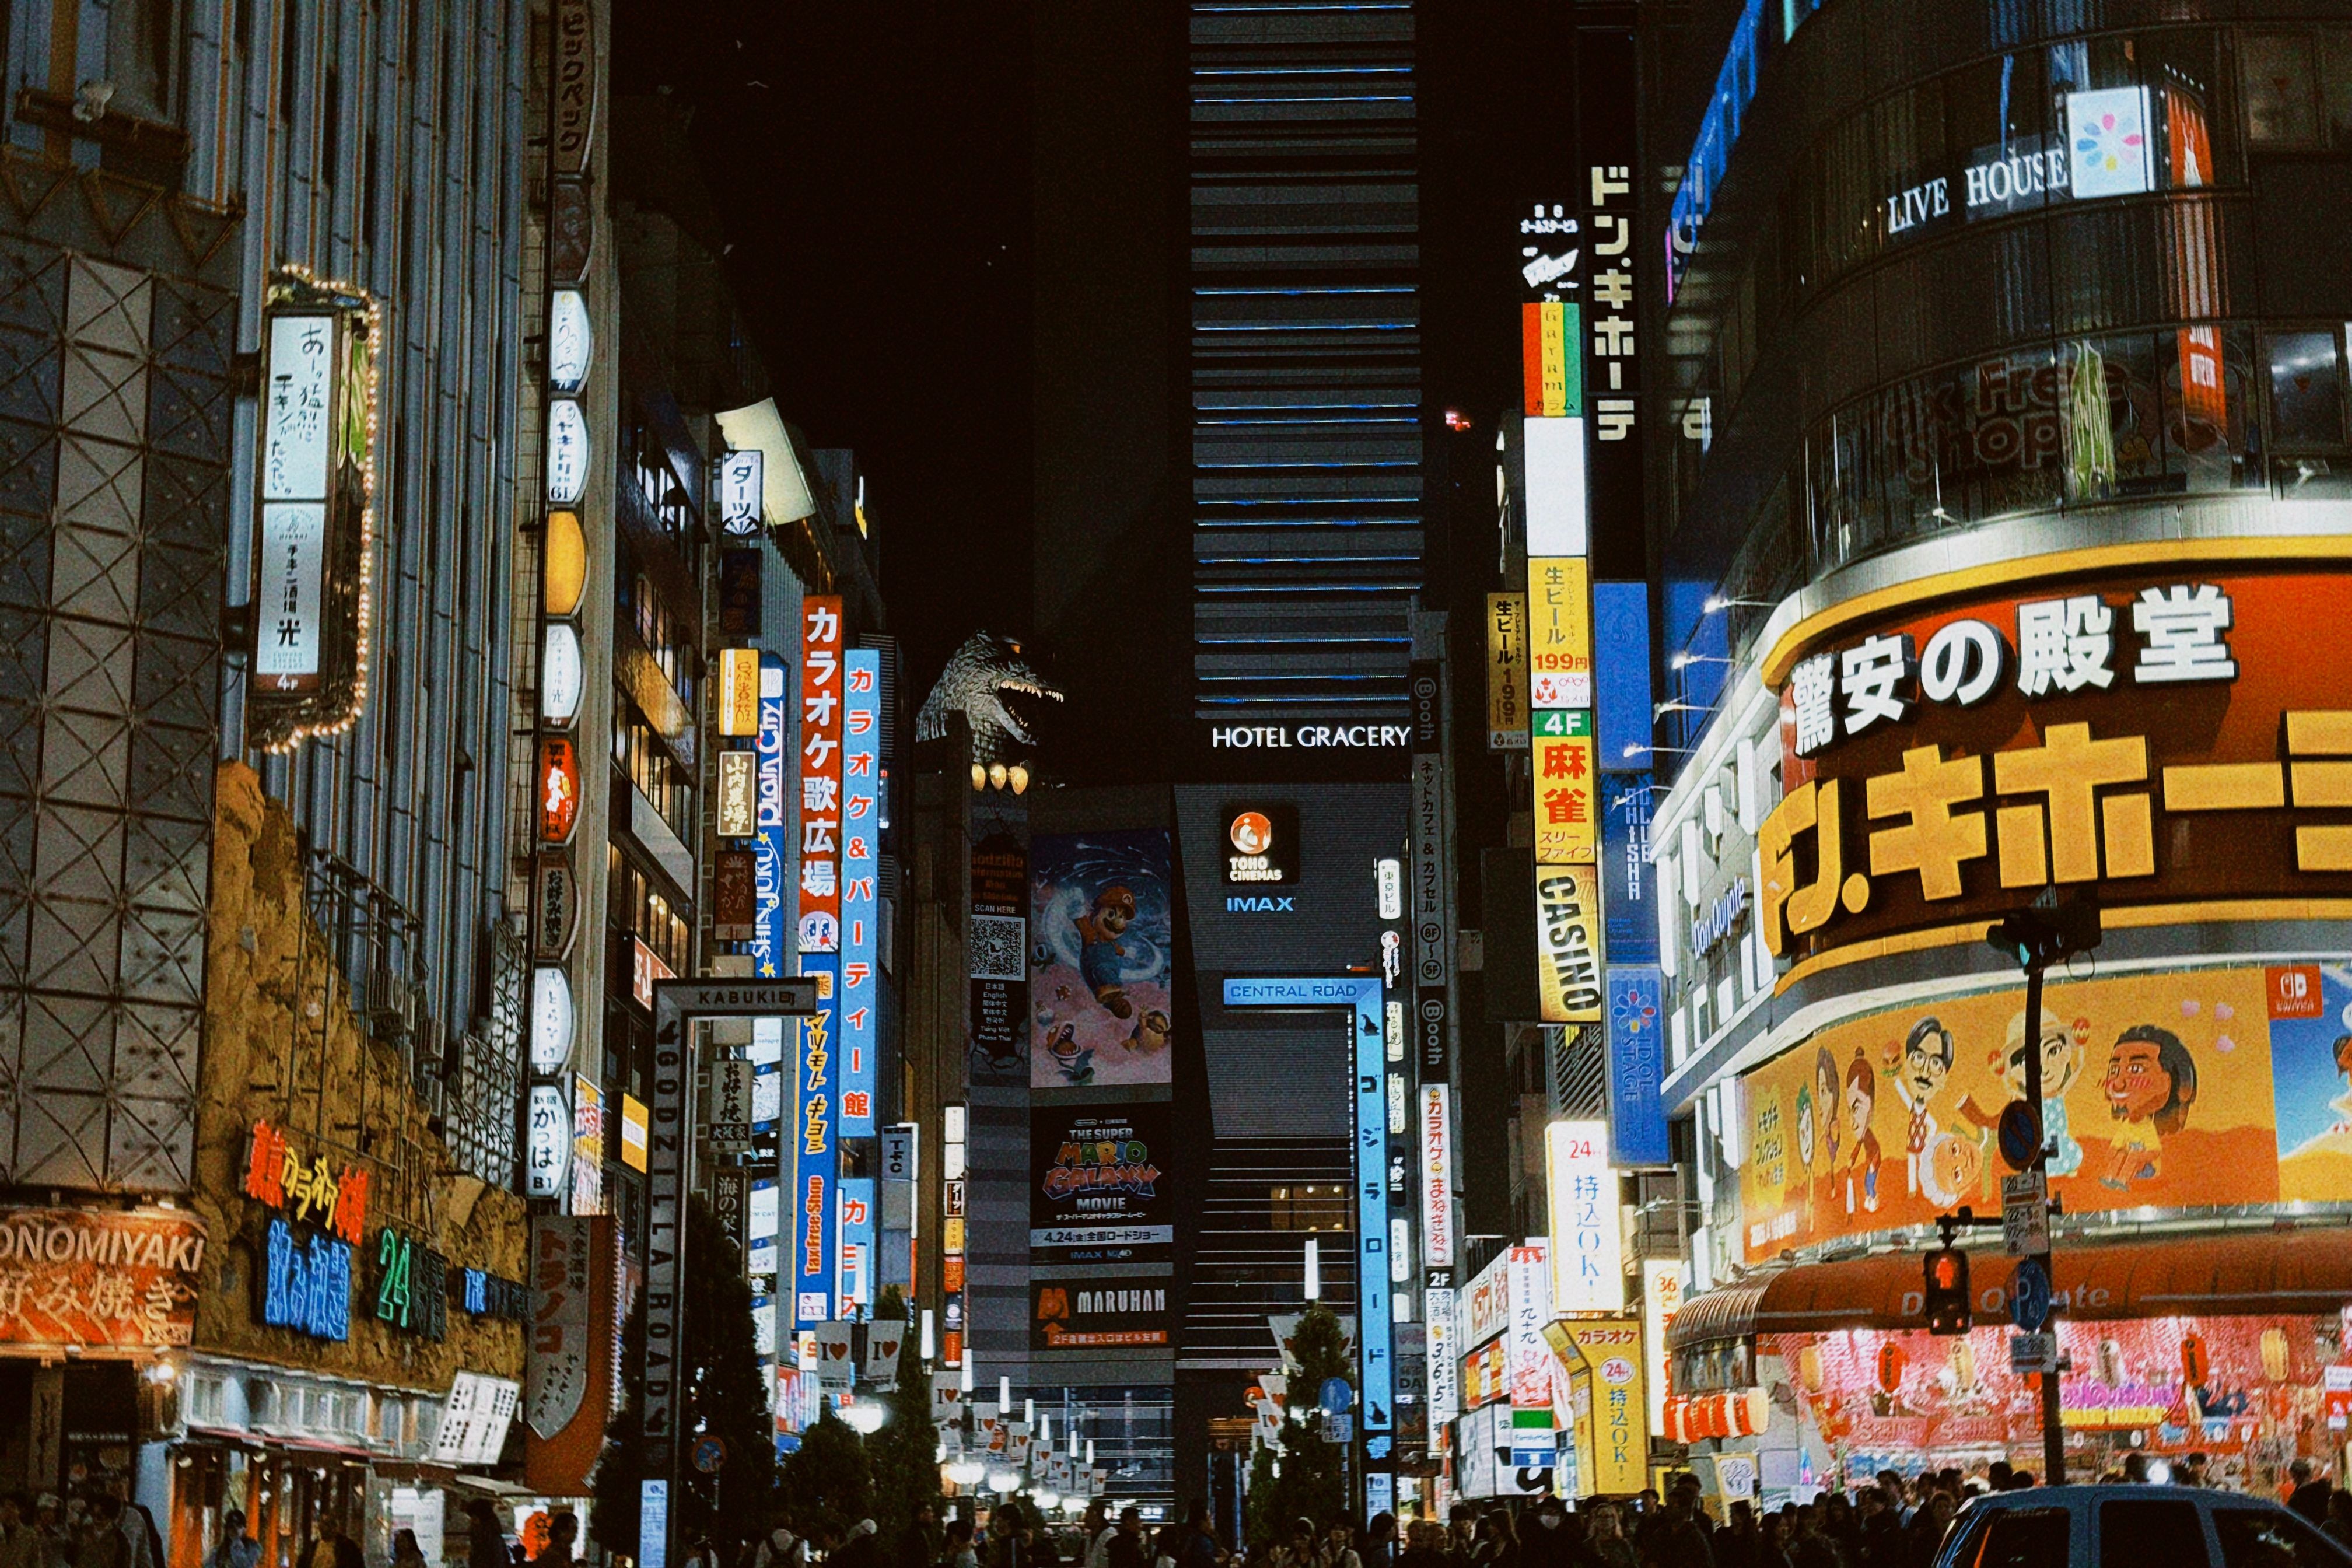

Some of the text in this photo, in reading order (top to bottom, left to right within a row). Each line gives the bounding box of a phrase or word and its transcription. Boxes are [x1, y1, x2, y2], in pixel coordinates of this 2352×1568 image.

[1887, 149, 2070, 235] LIVE HOUSE
[732, 465, 754, 520] ダーツ
[1544, 566, 1566, 646] 生ビール
[1496, 600, 1514, 664] 生ビール
[1535, 653, 1588, 670] 199円
[1791, 583, 2236, 757] 驚安の殿堂
[735, 660, 752, 724] 鳥貴族
[1212, 725, 1410, 748] HOTEL GRACERY
[1544, 713, 1581, 736] 4F
[801, 606, 840, 897] カラオケ歌広場
[1421, 761, 1435, 836] ネットカフェ
[1542, 742, 1587, 825] 麻雀
[1539, 831, 1581, 843] スリー
[1539, 845, 1594, 860] ファイブ
[1229, 857, 1268, 870] TOHO
[1229, 869, 1282, 881] CINEMAS
[545, 869, 563, 949] お好み焼き
[975, 904, 1017, 914] SCAN HERE
[1226, 897, 1294, 912] IMAX
[1384, 871, 1395, 914] 東京ビル
[1694, 875, 1745, 961] Don Quijote
[1538, 876, 1600, 1012] CASINO
[1230, 985, 1357, 998] CENTRAL ROAD
[1421, 999, 1444, 1065] Booth
[1069, 1128, 1133, 1140] THE SUPER
[1054, 1140, 1147, 1166] MARIO
[533, 1176, 554, 1190] B1
[805, 1175, 823, 1212] Shop
[1042, 1164, 1162, 1200] GALAXY
[1428, 1101, 1447, 1265] カラオケ まねきねこ
[1076, 1196, 1126, 1212] MOVIE
[1360, 1074, 1384, 1365] ゴジラロード
[648, 1051, 680, 1398] GODZILLA ROAD
[805, 1244, 823, 1276] Tax
[1070, 1251, 1102, 1259] IMAX
[1429, 1273, 1450, 1287] 2F
[1077, 1289, 1166, 1314] MARUHAN
[1518, 1307, 1537, 1345] 九十九
[1577, 1329, 1637, 1345] カラオケ
